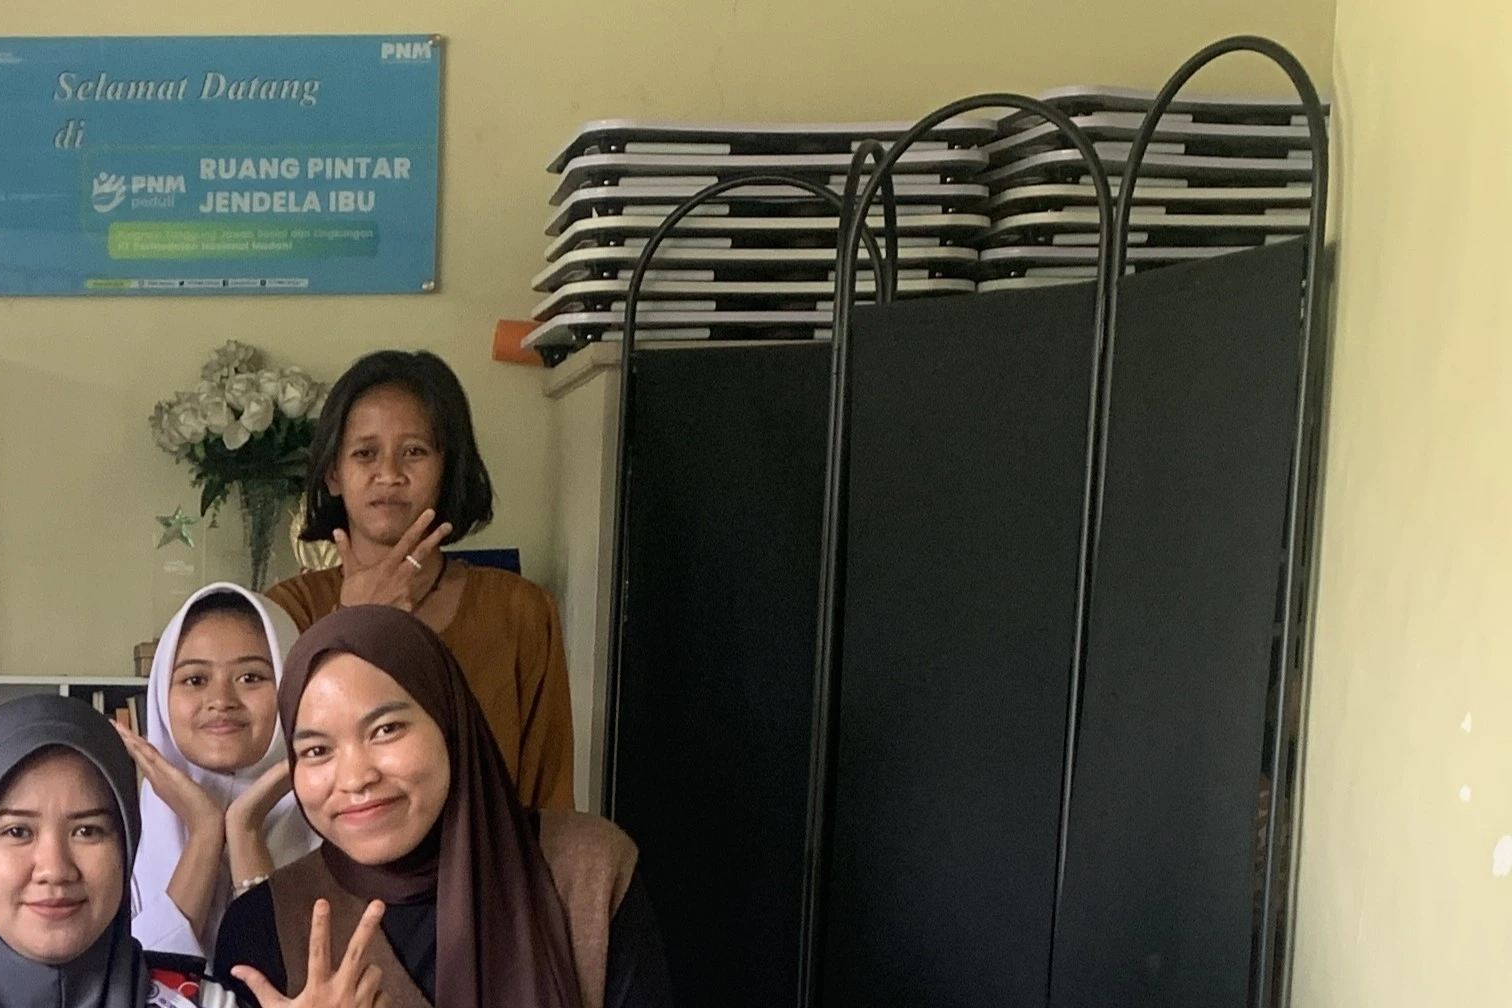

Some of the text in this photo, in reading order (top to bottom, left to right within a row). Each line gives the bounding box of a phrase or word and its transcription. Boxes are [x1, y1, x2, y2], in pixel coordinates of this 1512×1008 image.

[381, 43, 431, 59] PNM
[53, 72, 322, 107] Selamat Datang
[53, 119, 85, 149] di
[199, 157, 411, 180] RUANG PINTAR
[131, 175, 186, 194] PNM
[199, 191, 376, 213] JENDELA IBU
